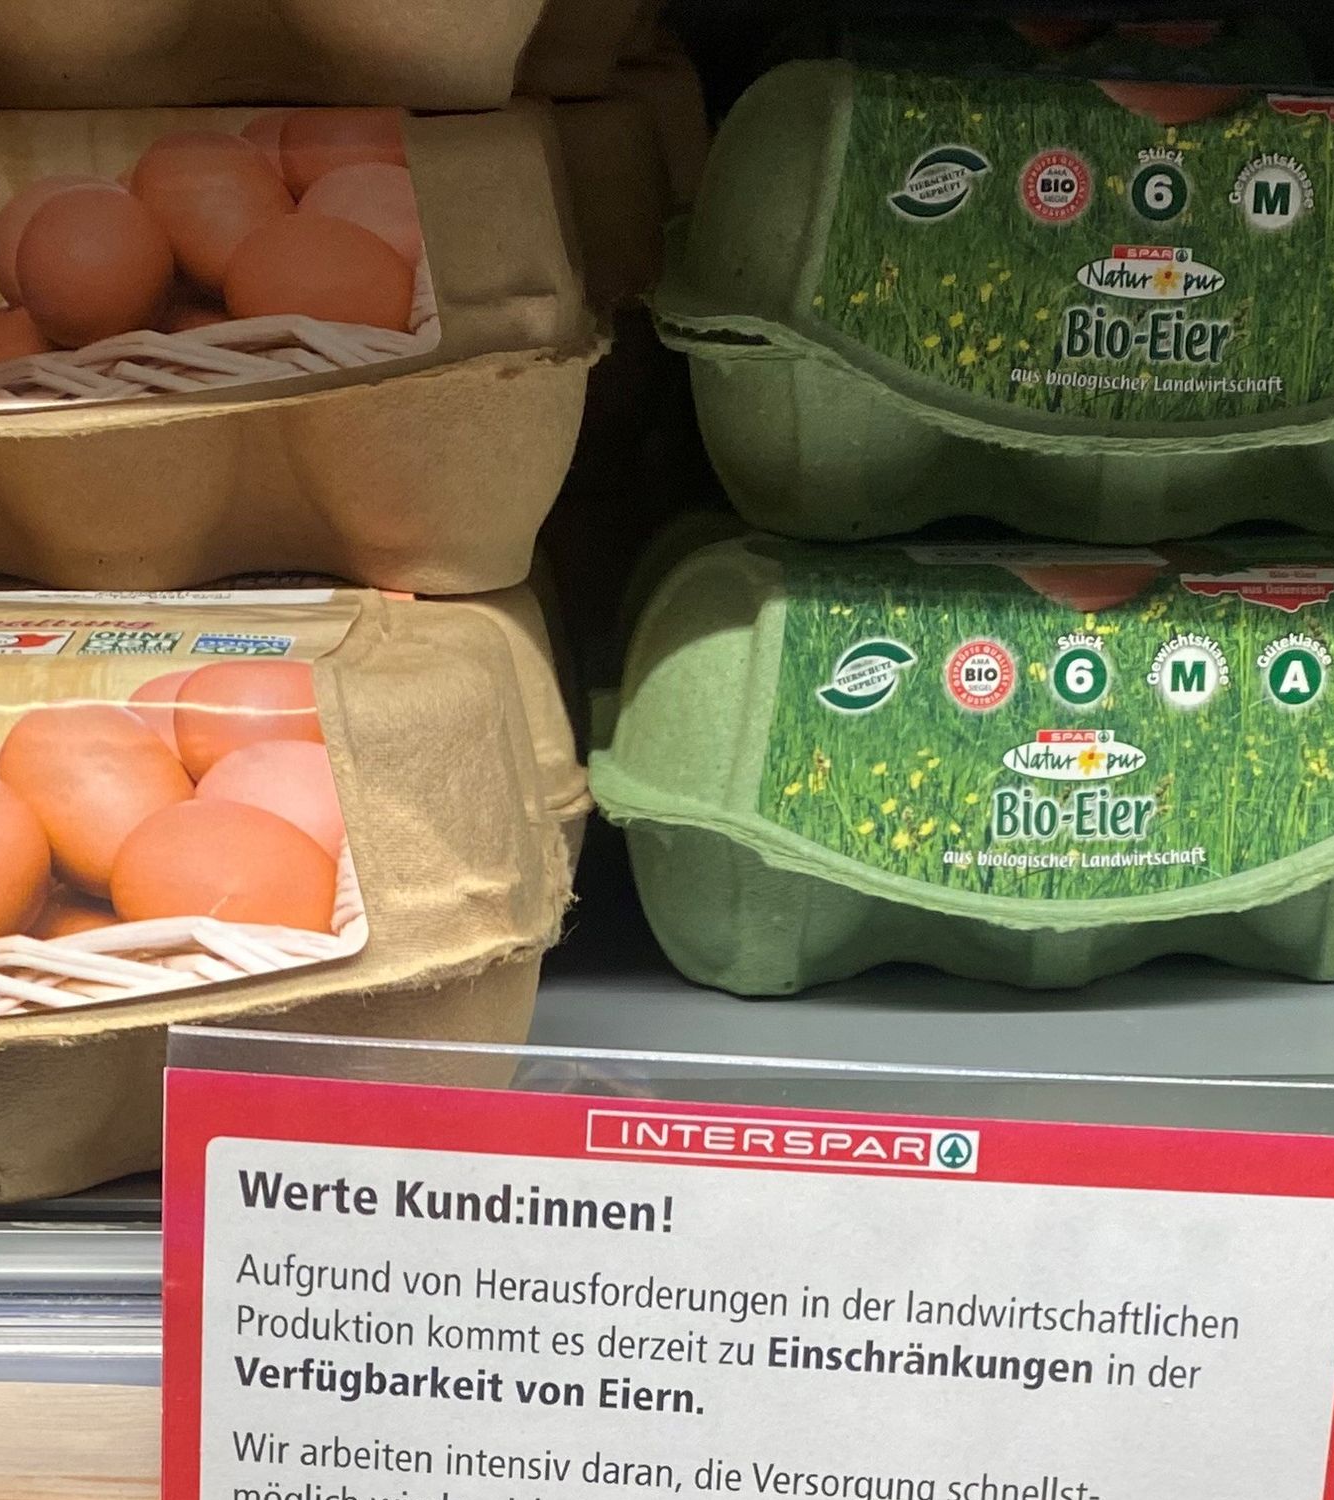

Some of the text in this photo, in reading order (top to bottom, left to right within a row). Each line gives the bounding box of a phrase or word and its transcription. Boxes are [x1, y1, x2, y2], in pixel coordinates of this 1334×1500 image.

[1145, 174, 1173, 210] 6
[1253, 181, 1291, 216] M
[1086, 261, 1222, 295] Natur pur
[1068, 308, 1230, 363] Bio-Eier
[1046, 368, 1283, 394] biologischer Landwirtschaft
[1057, 633, 1104, 652] Stück
[1146, 633, 1231, 687] Gewichtsklasse
[1256, 633, 1332, 669] Güteklasse
[965, 668, 997, 681] BIO
[1065, 659, 1093, 692] 6
[1169, 661, 1206, 693] M
[1278, 661, 1311, 693] A
[1050, 731, 1096, 741] SPAR
[1011, 746, 1144, 776] Natur pur
[995, 791, 1154, 840] Bio-Eier
[944, 846, 1206, 870] aus biologischer Landwirtschaft
[621, 1119, 925, 1162] INTERSPAR
[238, 1169, 674, 1233] Werte Kund:innen!
[237, 1253, 1239, 1340] Aufgrund von Herausforderungen in der landwirtschaftlichen
[237, 1305, 1201, 1390] Produktion kommt es derzeit zu Einschränkungen in der
[234, 1356, 705, 1415] Verfügbarkeit von Eiern.
[233, 1430, 289, 1465] Wir
[300, 1435, 433, 1475] arbeiten
[446, 1443, 571, 1482] intensiv
[582, 1450, 683, 1494] daran,
[694, 1457, 743, 1492] die
